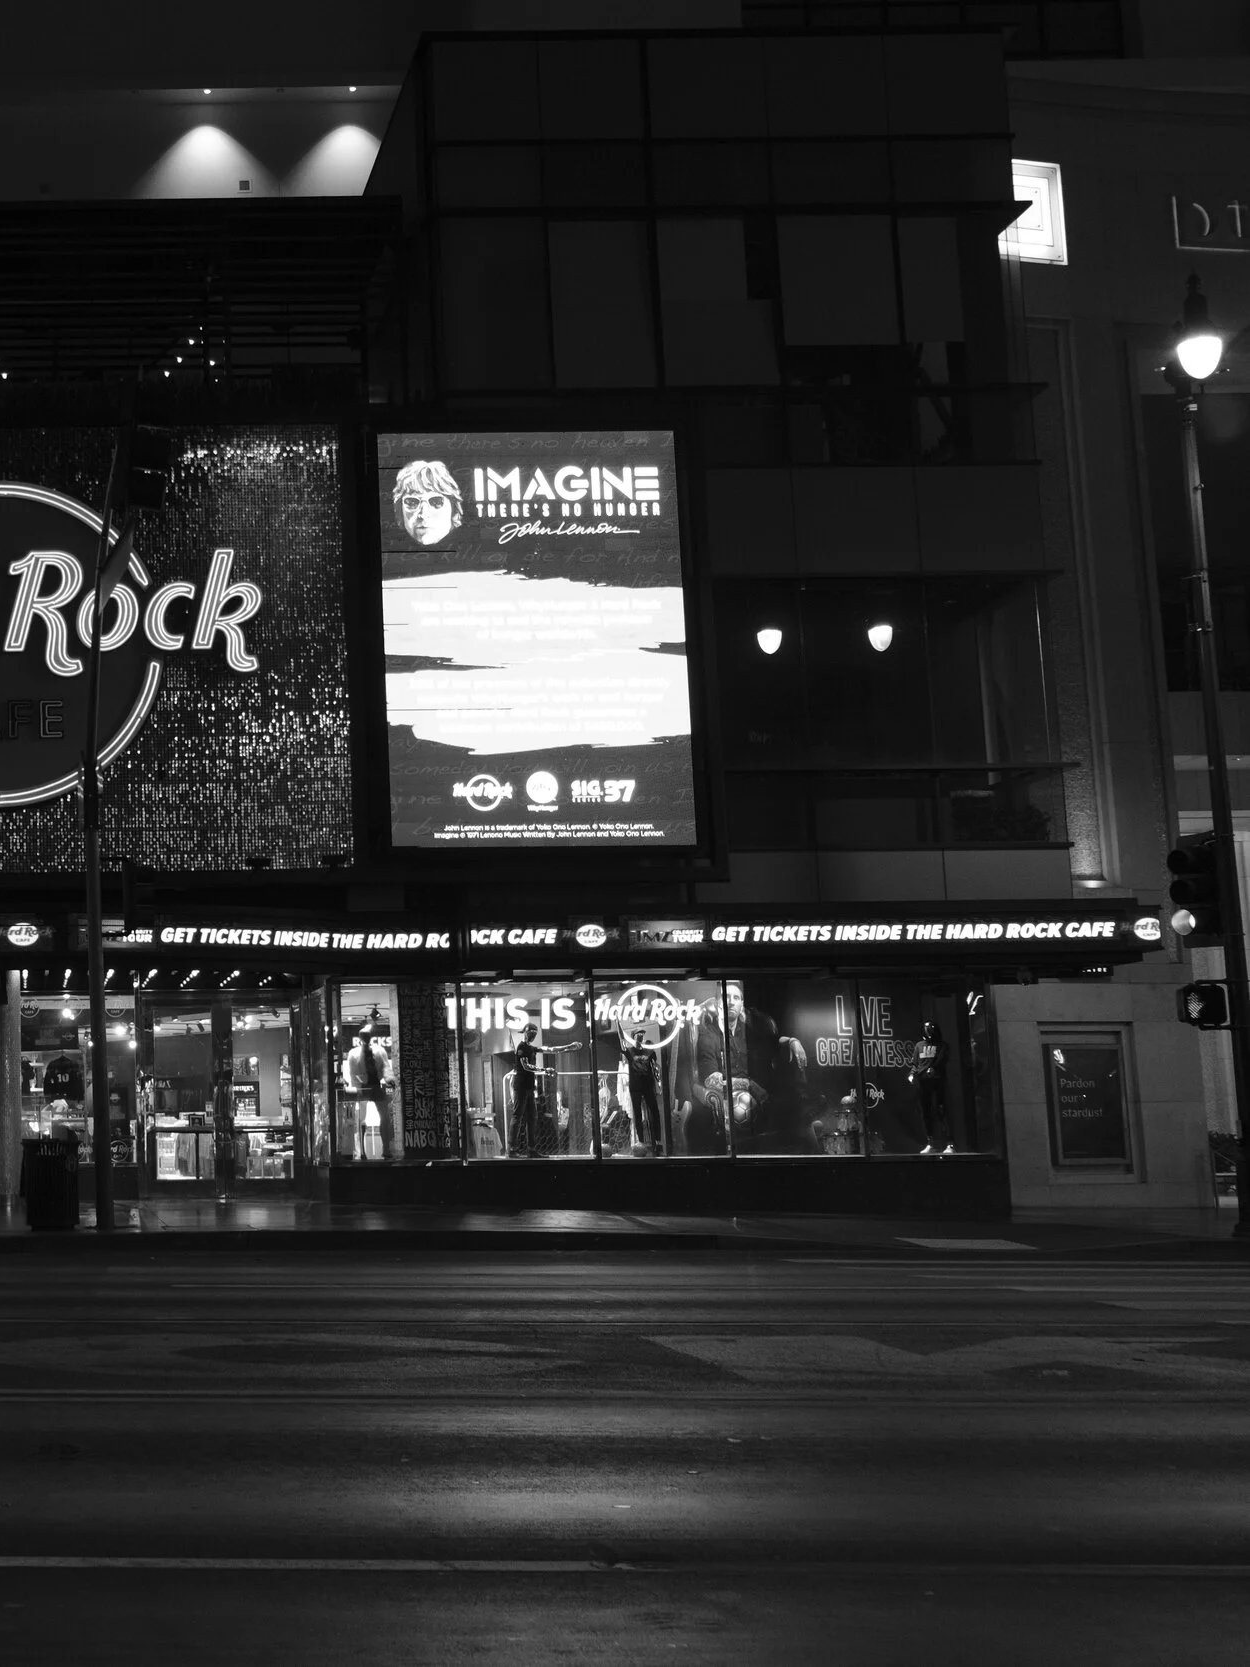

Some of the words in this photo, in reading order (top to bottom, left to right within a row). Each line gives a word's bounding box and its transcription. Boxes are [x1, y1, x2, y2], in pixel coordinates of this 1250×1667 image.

[474, 465, 661, 502] IMAGINE
[476, 502, 550, 518] THERE'S
[561, 502, 583, 517] NO
[593, 502, 661, 517] HUNGER
[3, 548, 263, 677] Rock
[604, 779, 636, 802] 37
[443, 824, 460, 832] John
[461, 824, 484, 832] Lennon
[496, 824, 528, 832] trademark
[528, 824, 535, 832] of
[536, 824, 552, 832] Yoko
[553, 824, 567, 832] Ono
[599, 823, 615, 831] Yoko
[615, 823, 629, 831] Ono
[160, 927, 197, 943] GET
[199, 928, 272, 946] TICKETS
[273, 931, 330, 948] INSIDE
[332, 933, 363, 949] THE
[366, 933, 424, 950] HARD
[507, 929, 558, 945] CAFE
[671, 934, 704, 944] TOUR
[711, 926, 750, 942] GET
[752, 925, 833, 942] TICKETS
[834, 925, 902, 941] INSIDE
[905, 924, 944, 940] THE
[945, 923, 1004, 940] HARD
[1004, 922, 1064, 939] ROCK
[1064, 921, 1116, 938] CAFE
[445, 997, 530, 1031] THIS
[541, 998, 576, 1030] IS
[594, 999, 648, 1023] Hard
[649, 999, 702, 1026] Rock
[835, 995, 893, 1037] LVE
[352, 1037, 393, 1048] RCKS
[1059, 1077, 1096, 1089] Pardon
[1061, 1106, 1103, 1119] stardust
